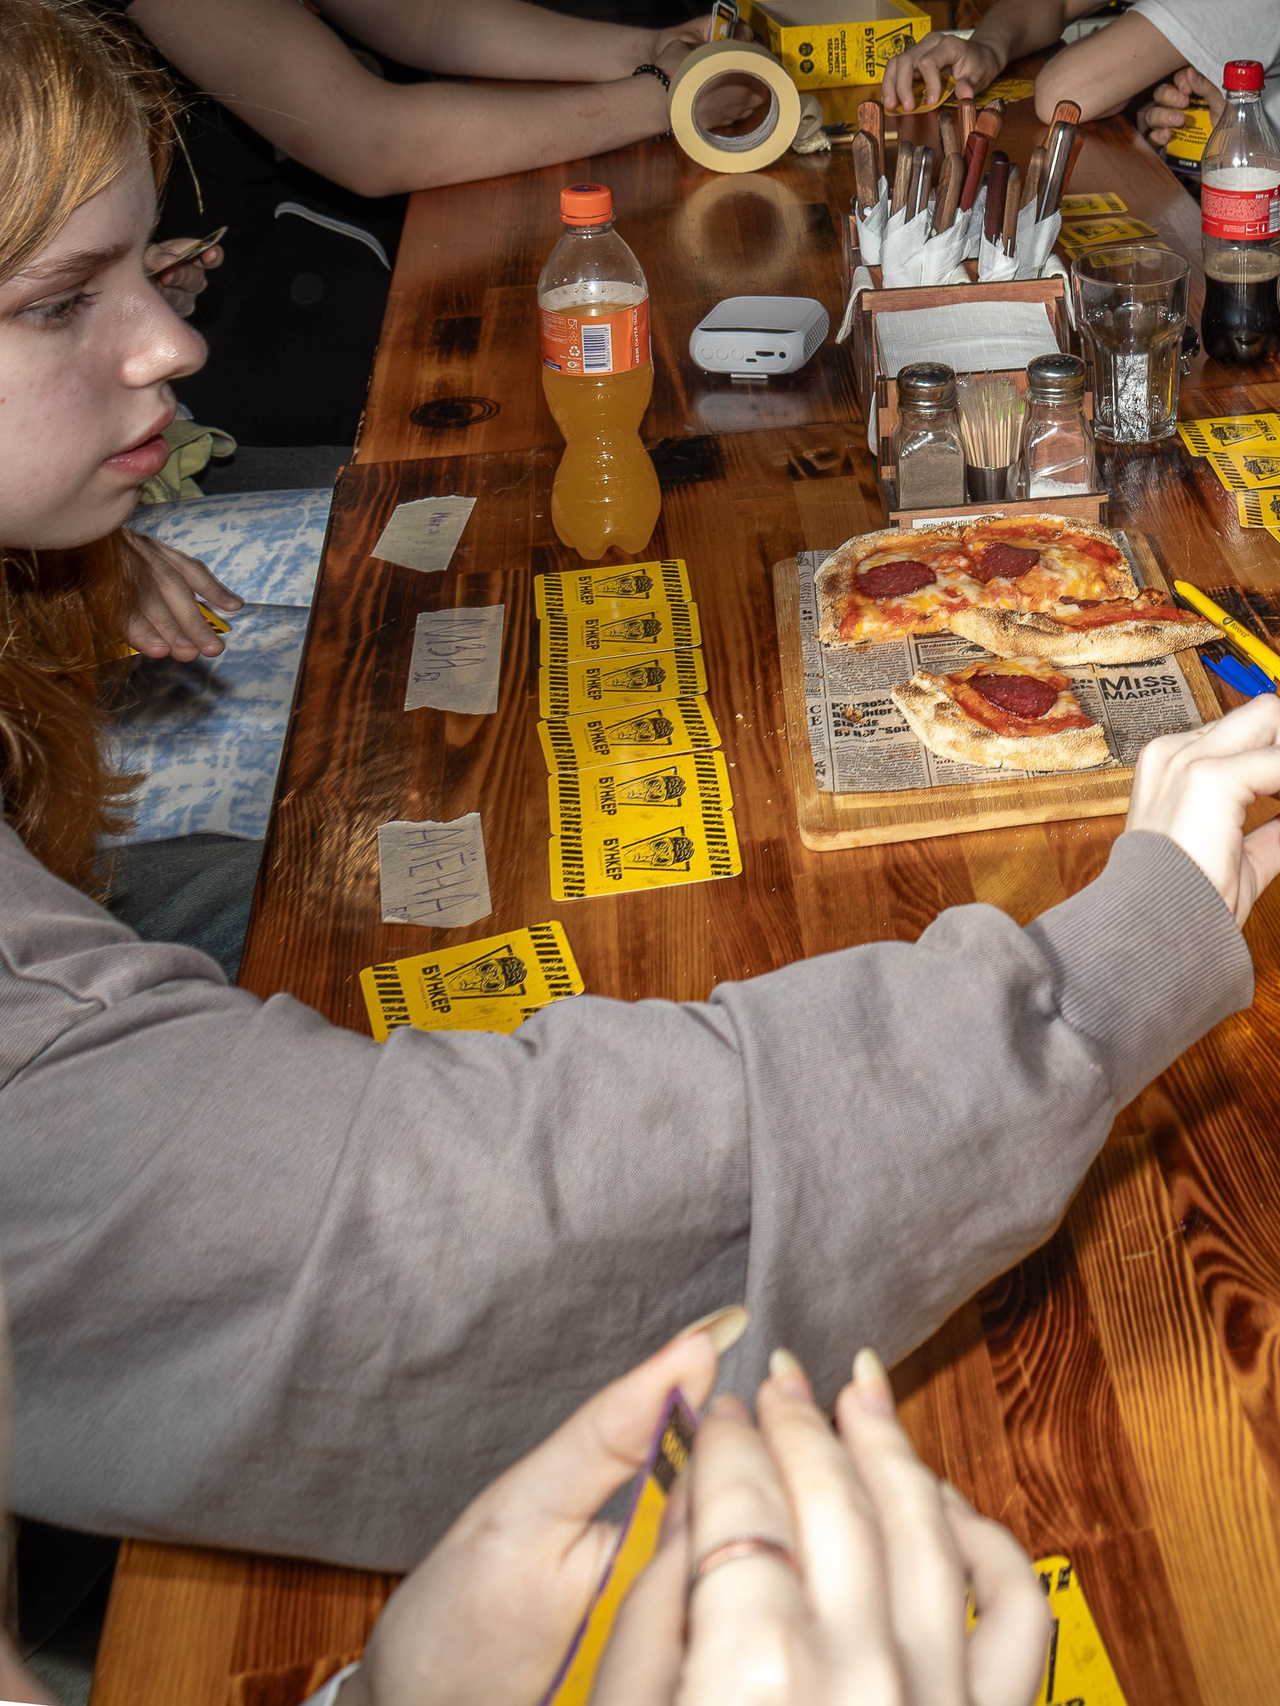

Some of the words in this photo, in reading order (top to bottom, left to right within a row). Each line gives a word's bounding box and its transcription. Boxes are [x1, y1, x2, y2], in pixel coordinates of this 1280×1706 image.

[865, 28, 876, 77] БУНКЕР
[1254, 419, 1277, 442] БУНКЕР
[579, 576, 594, 605] БУНКЕР
[586, 619, 600, 650] БУНКЕР
[586, 668, 602, 700] БУНКЕР
[1103, 686, 1182, 700] MARPLE
[587, 720, 610, 756] БУНКЕР
[598, 776, 617, 816] БУНКЕР
[404, 828, 481, 920] АЛЁНА
[603, 838, 622, 881] БУНКЕР
[422, 964, 452, 1014] БУНКЕР
